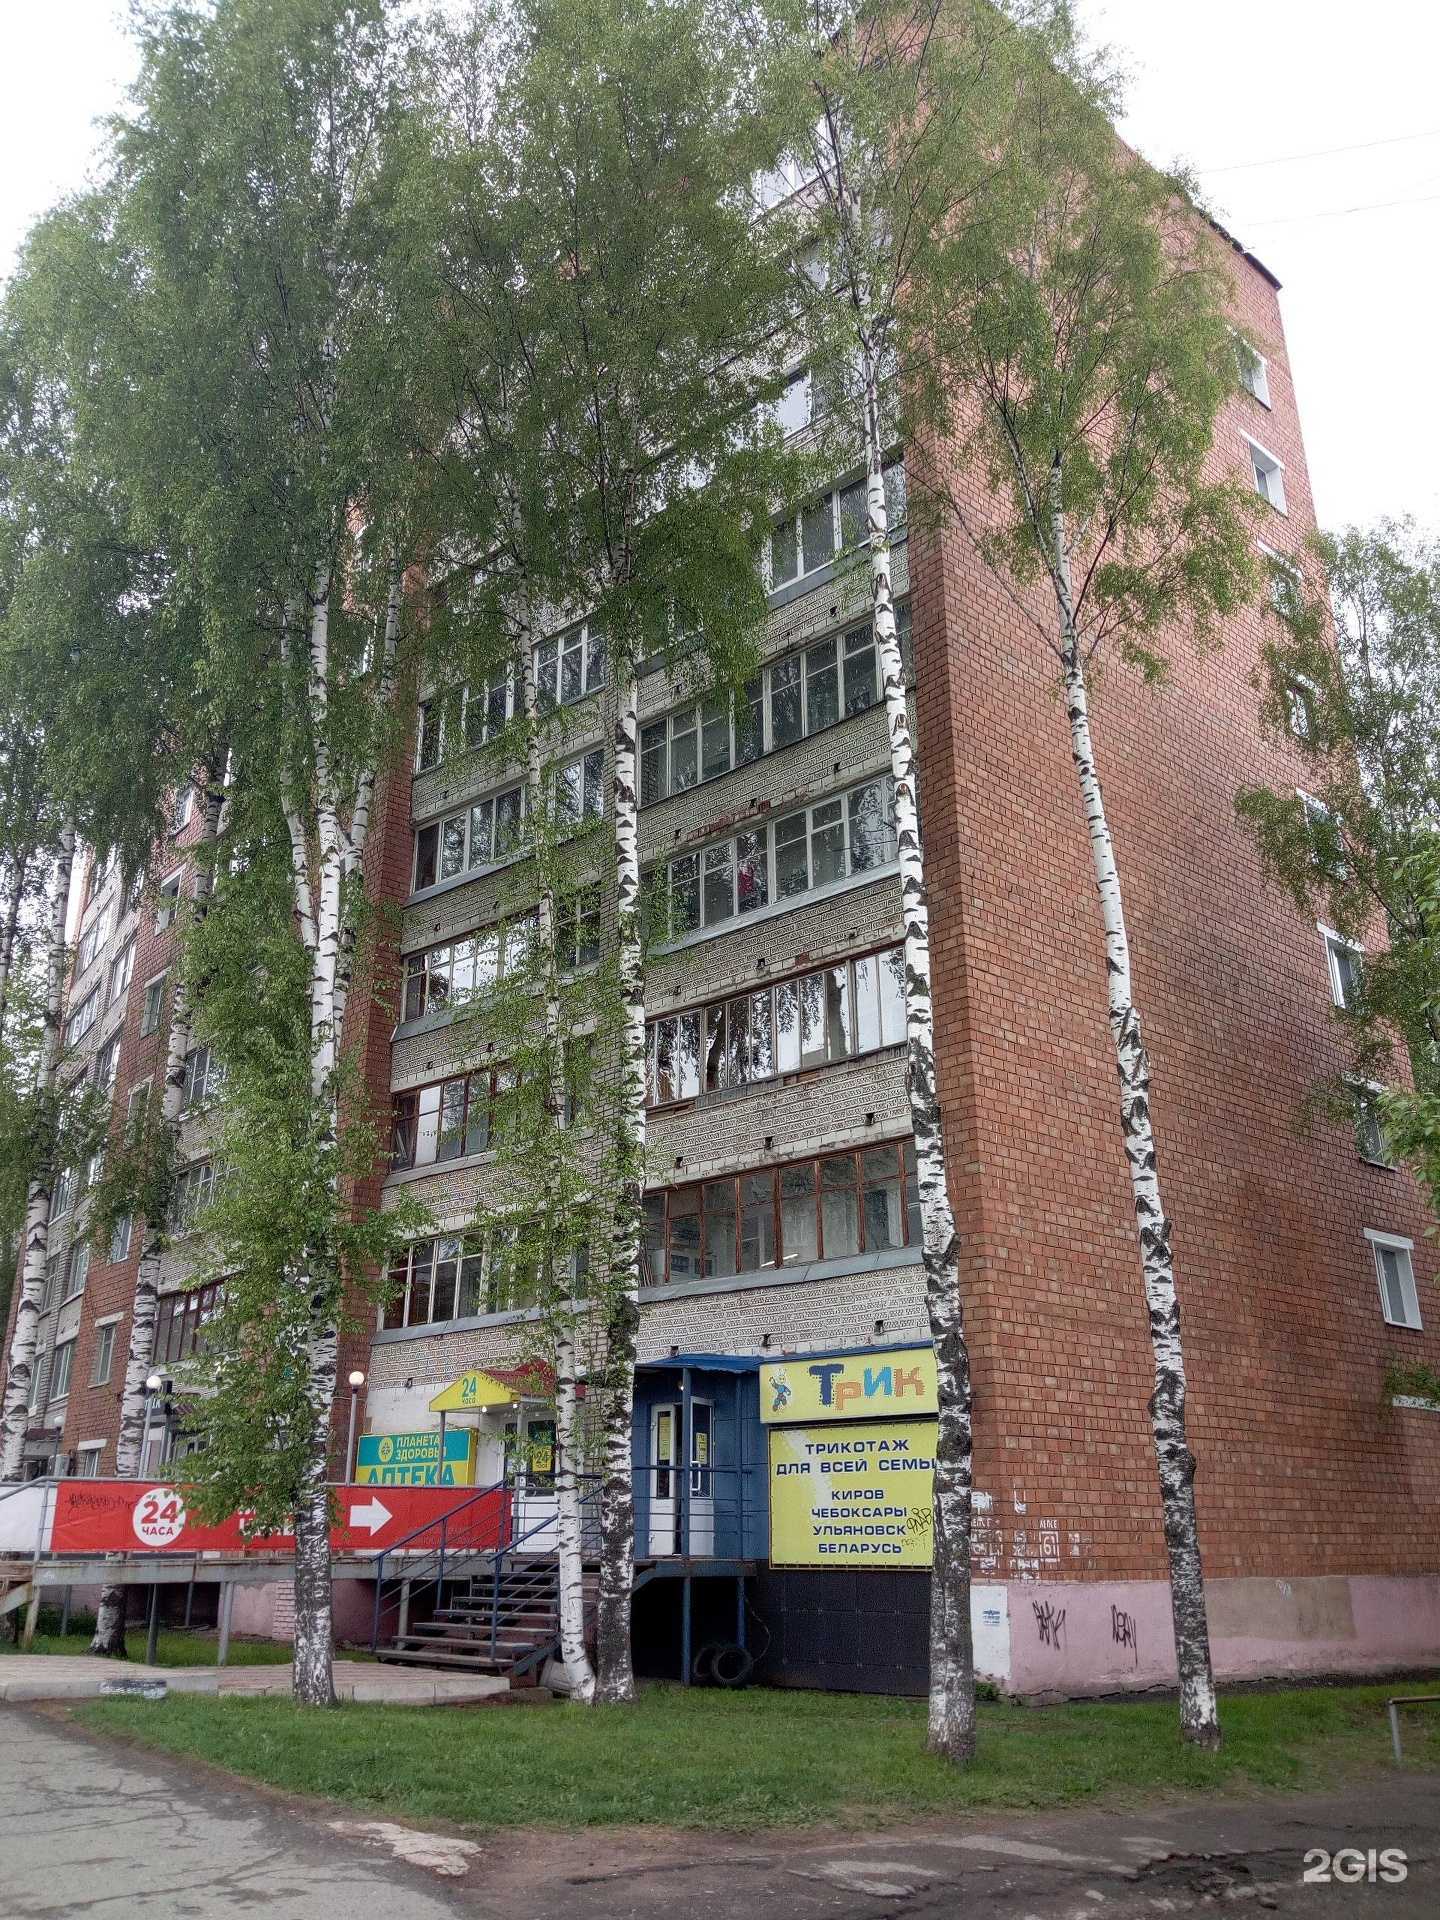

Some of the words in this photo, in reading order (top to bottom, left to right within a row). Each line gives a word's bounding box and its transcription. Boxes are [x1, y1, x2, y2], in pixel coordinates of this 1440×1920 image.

[462, 1376, 477, 1397] 24
[396, 1434, 441, 1448] ПЛАНЕТА
[805, 1439, 910, 1455] ТРИКОТАЖ
[368, 1463, 455, 1486] АПТЕКА
[776, 1462, 811, 1476] ДЛЯ
[820, 1458, 868, 1474] ВСЕЙ
[831, 1489, 885, 1501] КИРОВ
[141, 1499, 179, 1524] 24
[811, 1507, 907, 1519] ЧЕБОКСАРЫ
[142, 1526, 174, 1536] ЧАСА
[813, 1525, 906, 1537] УЛЬЯНОВСК
[818, 1543, 903, 1554] БЕЛАРУСЬ
[1043, 1535, 1057, 1556] 61
